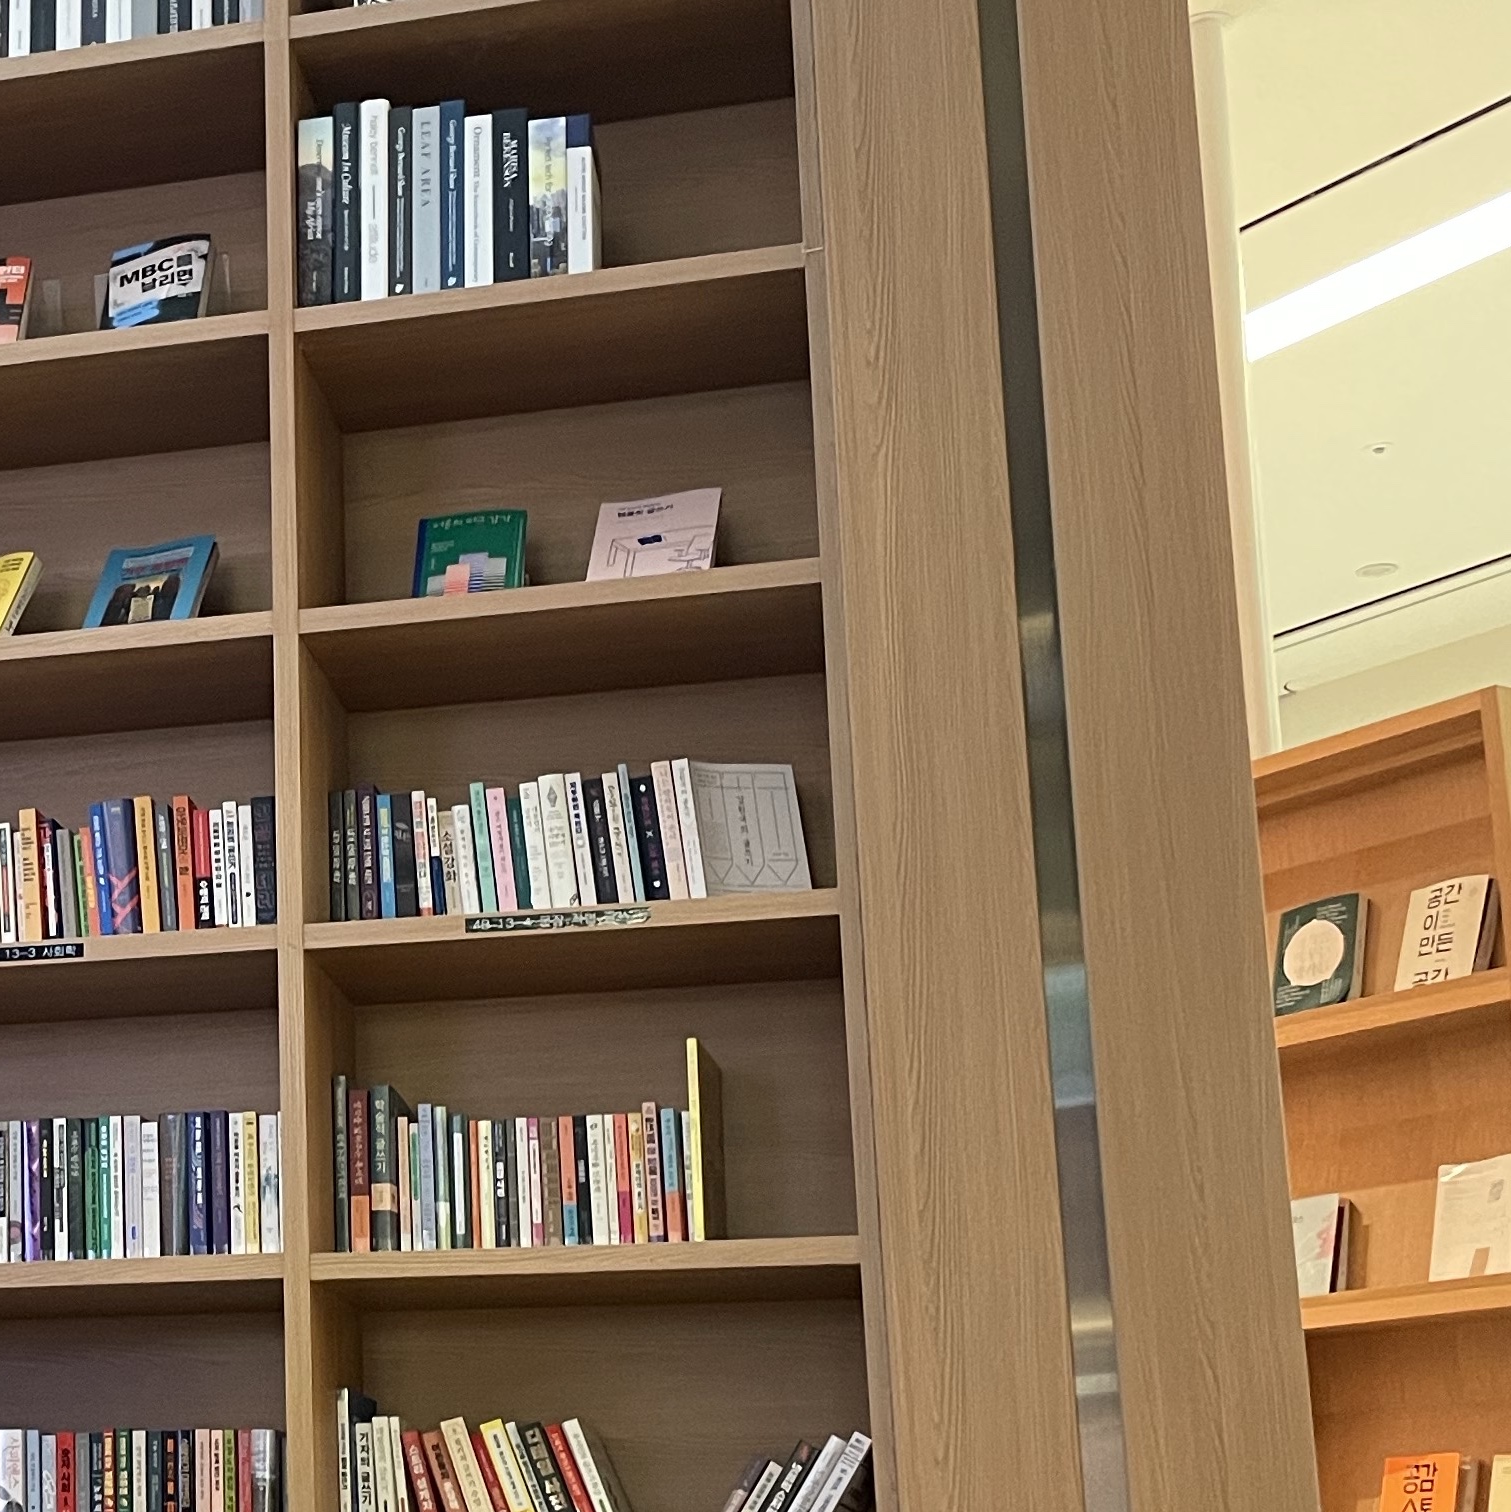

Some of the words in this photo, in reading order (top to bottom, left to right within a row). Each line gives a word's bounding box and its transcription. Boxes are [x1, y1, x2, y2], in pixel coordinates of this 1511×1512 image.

[472, 126, 484, 178] Ornament
[419, 166, 432, 209] AREA
[1427, 882, 1463, 910] 공간
[1423, 910, 1440, 931] 이
[4, 948, 37, 959] 13-3
[42, 945, 78, 958] 사회학
[1417, 931, 1455, 958] 만든
[359, 1431, 371, 1468] 기자의
[361, 1471, 373, 1506] 글쓰기
[1402, 1461, 1439, 1495] 공감
